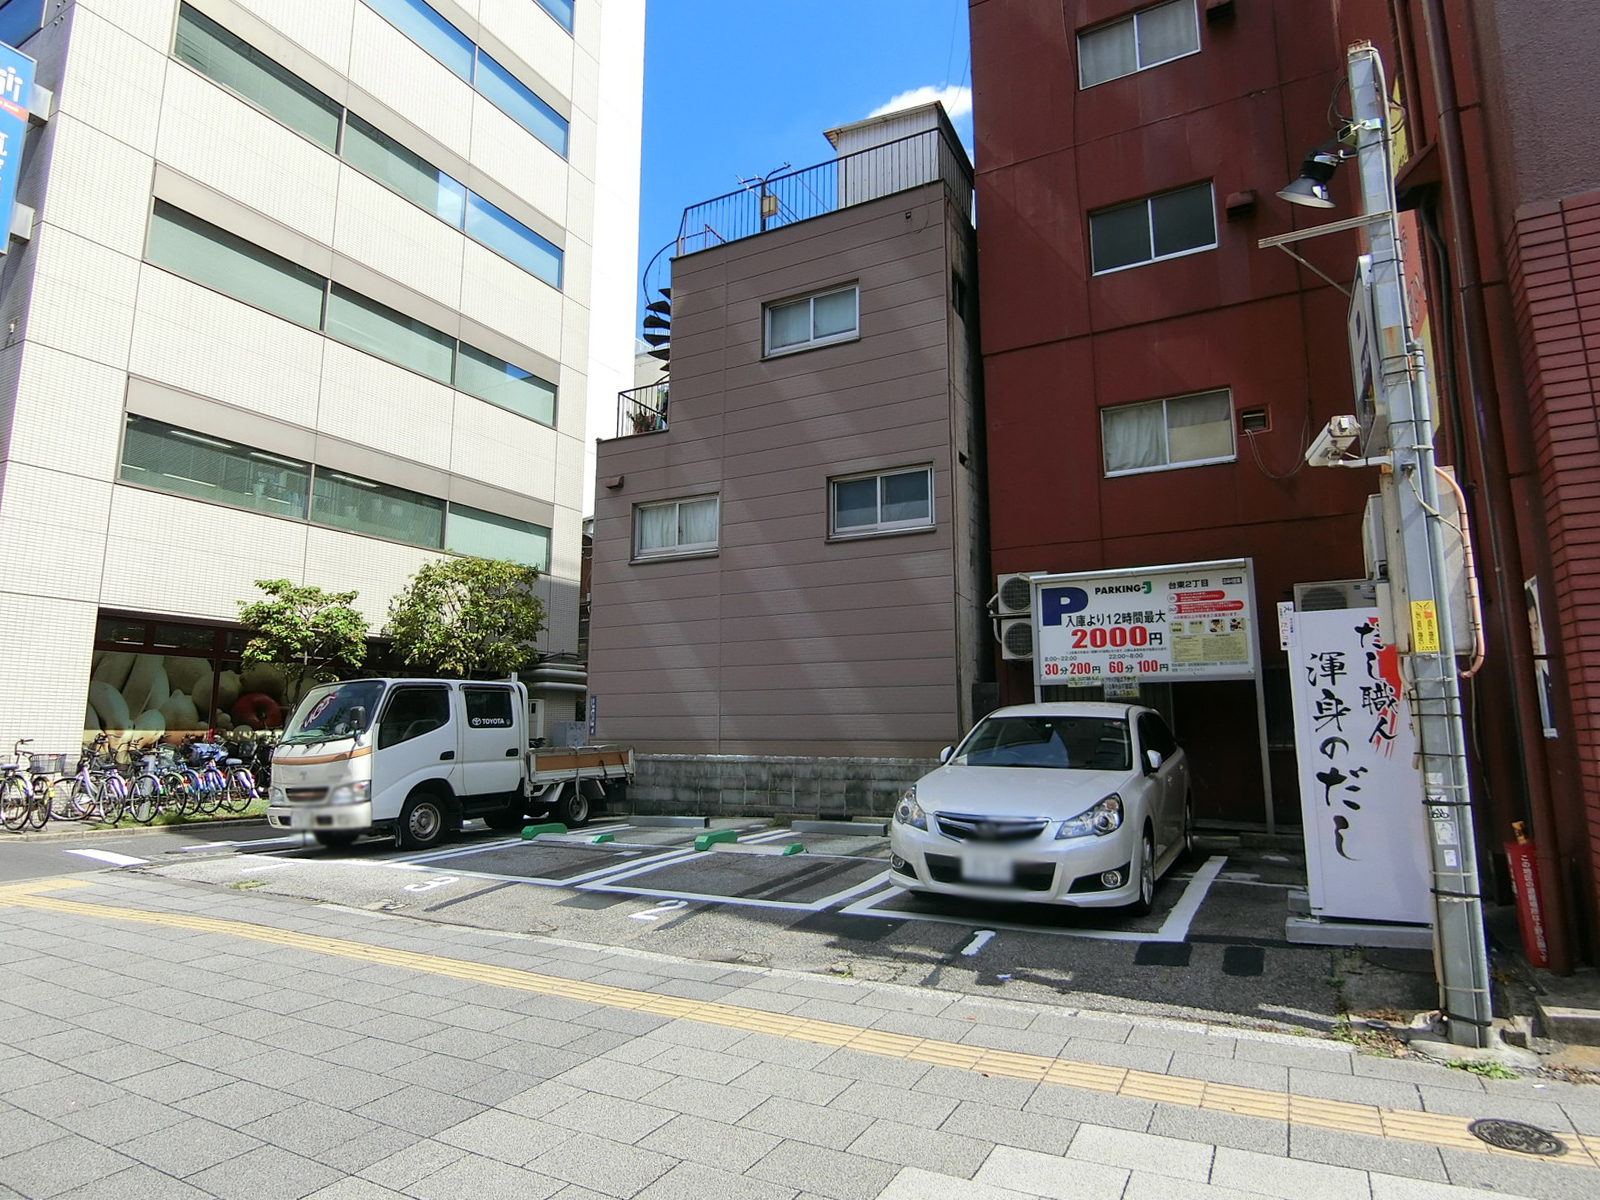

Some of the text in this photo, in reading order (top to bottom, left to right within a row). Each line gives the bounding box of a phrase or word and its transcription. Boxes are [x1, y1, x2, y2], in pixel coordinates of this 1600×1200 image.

[1168, 579, 1209, 589] 台東2丁目
[1041, 586, 1089, 627] P
[1065, 609, 1167, 628] 入庫より12時間最大
[1070, 626, 1163, 649] 2000円
[1305, 651, 1369, 861] 渾身のだし
[403, 876, 460, 893] 3
[627, 899, 689, 921] 2
[960, 929, 997, 956] 1
